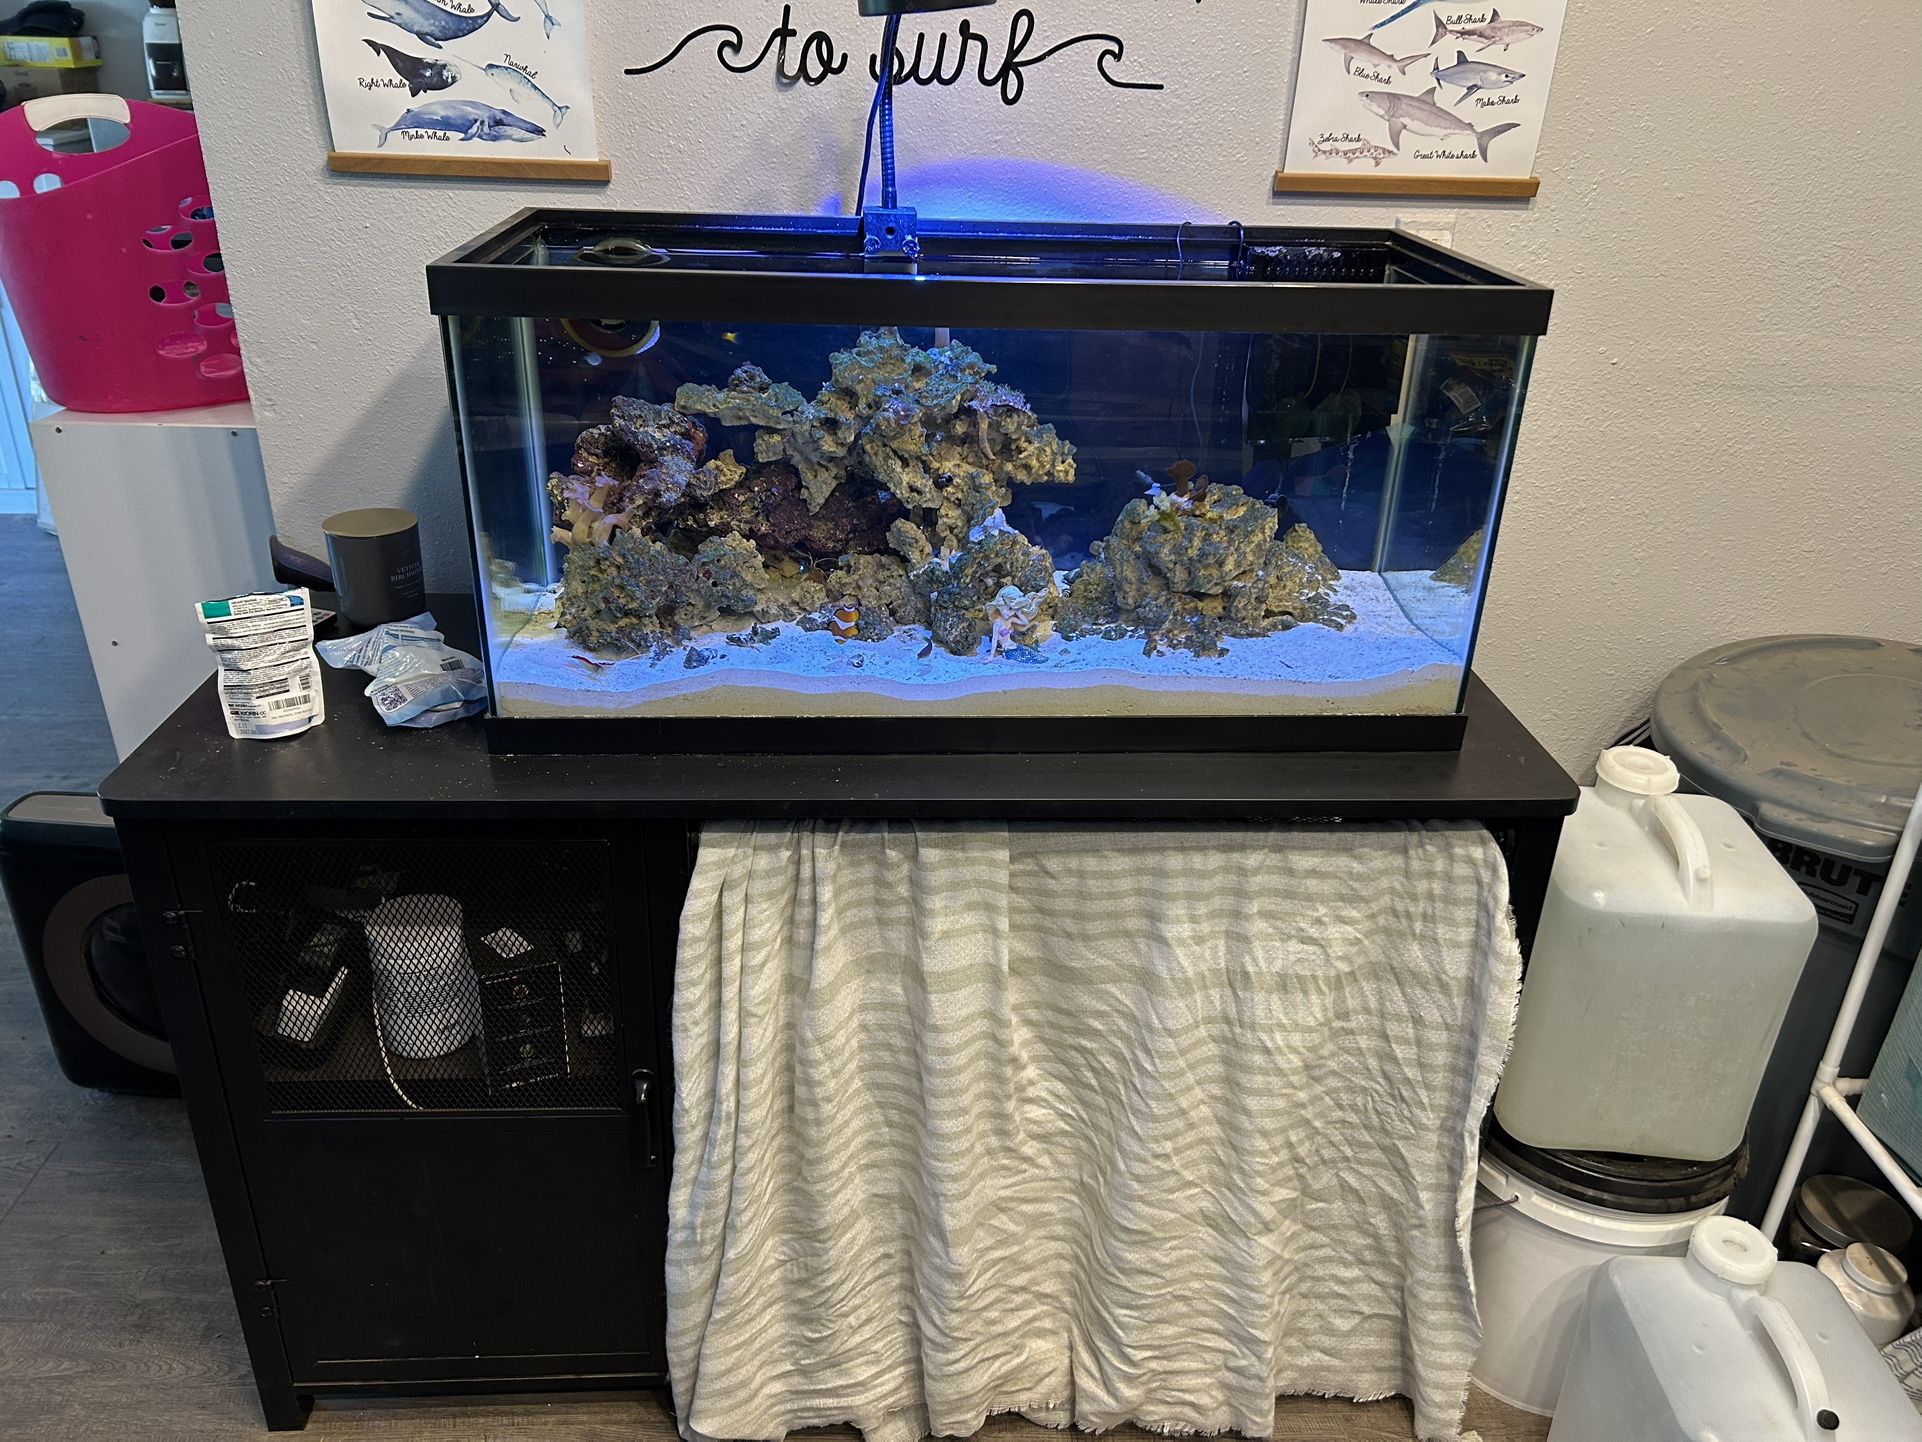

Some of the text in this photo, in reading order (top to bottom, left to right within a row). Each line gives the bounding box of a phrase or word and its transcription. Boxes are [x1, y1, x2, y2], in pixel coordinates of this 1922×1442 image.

[1446, 13, 1487, 25] Bull Shark
[772, 4, 1035, 106] to surf
[503, 53, 539, 80] Narwhal
[1353, 66, 1392, 85] Blue Shark
[357, 77, 407, 91] Right Whale
[1475, 94, 1519, 108] Mako Shark
[425, 131, 451, 142] Whale
[1318, 132, 1363, 145] Zebra Shark
[1413, 150, 1434, 160] Great
[1434, 149, 1455, 160] White
